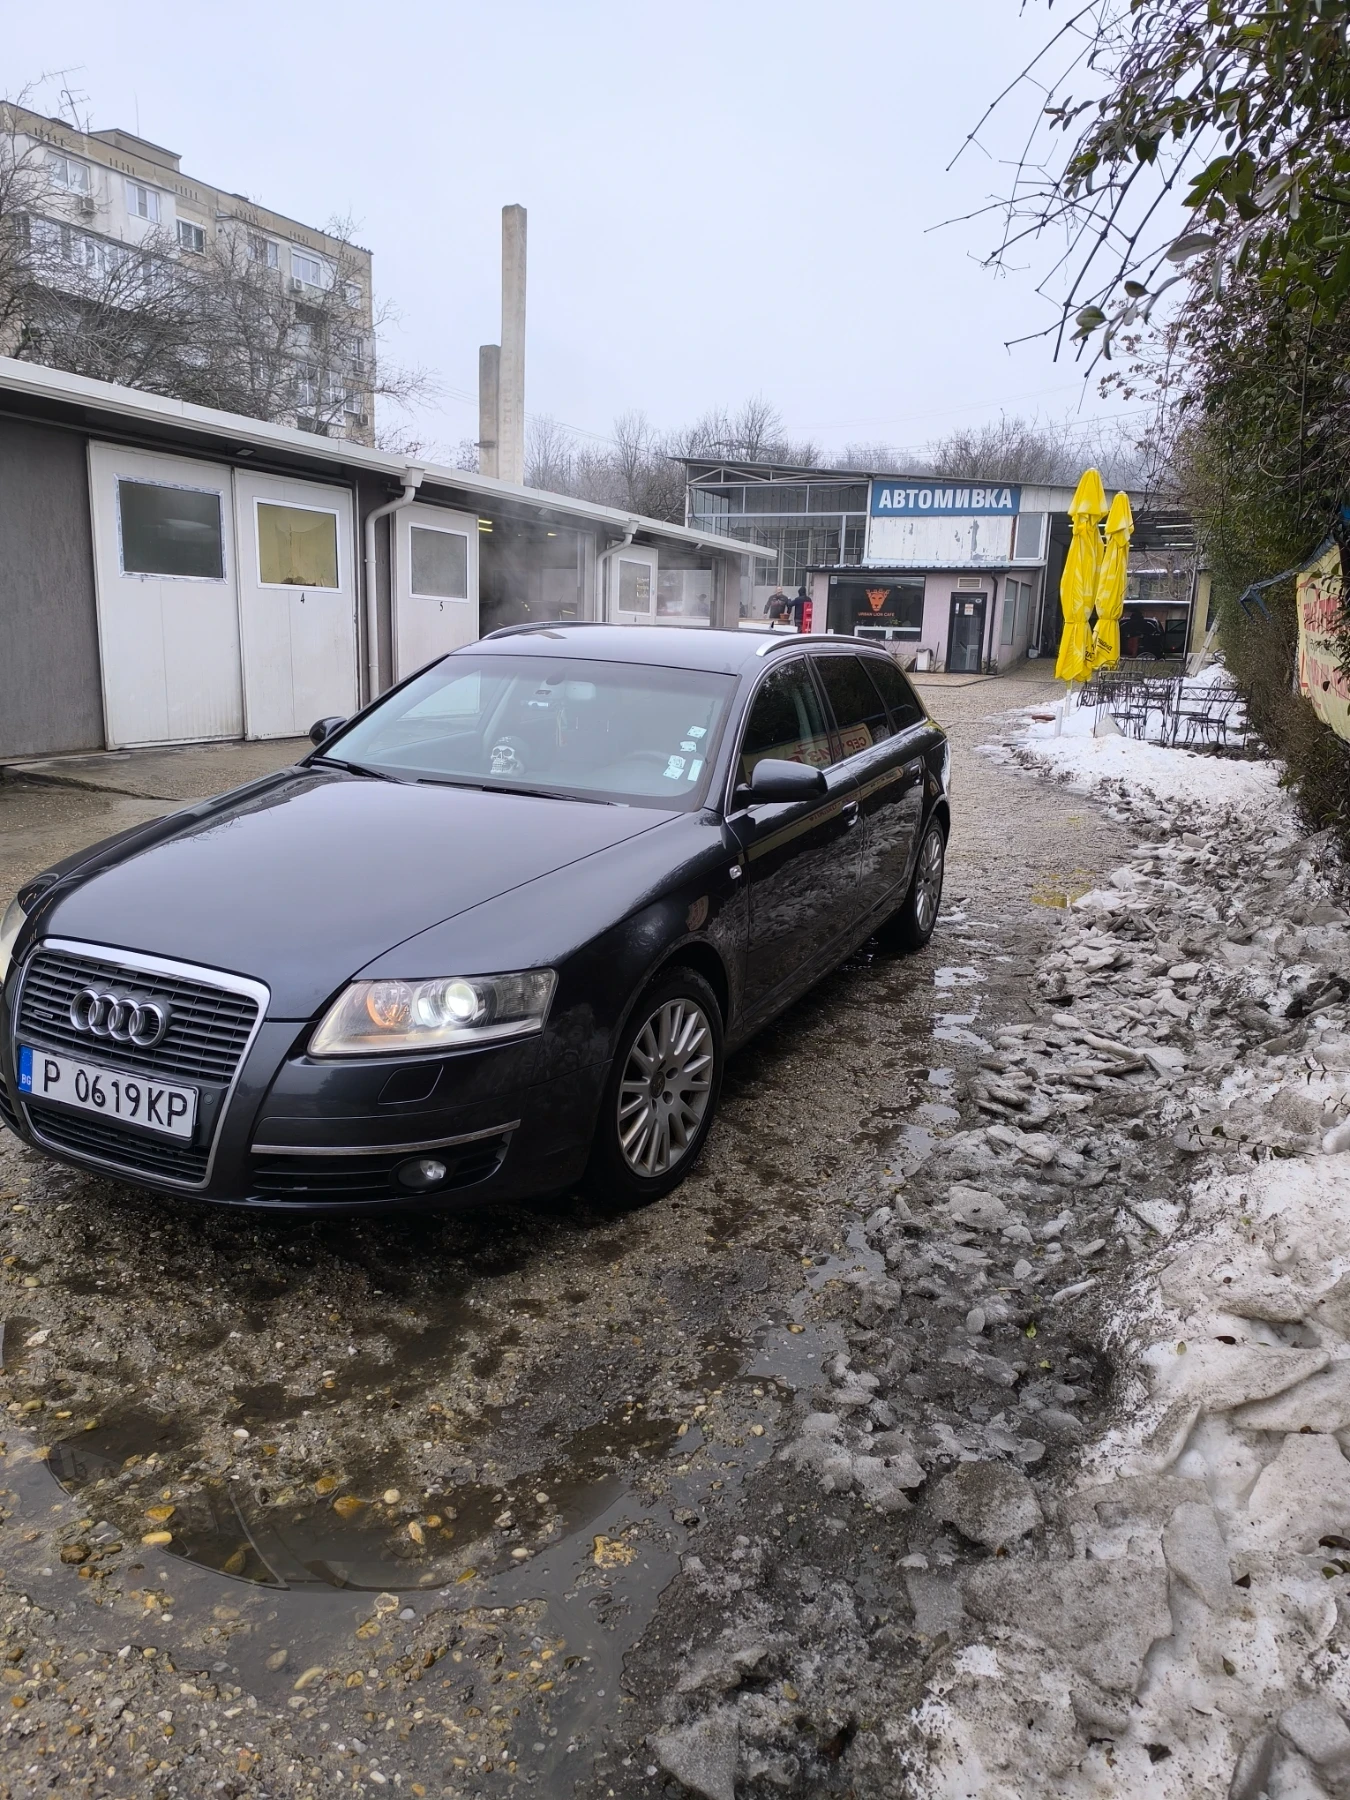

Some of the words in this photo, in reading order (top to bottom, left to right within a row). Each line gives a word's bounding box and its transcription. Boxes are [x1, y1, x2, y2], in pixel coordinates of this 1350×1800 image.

[879, 488, 1013, 509] АВТОМИВКА
[300, 592, 306, 604] 4
[439, 601, 444, 612] 5
[21, 1073, 32, 1086] BG
[43, 1059, 61, 1093] P
